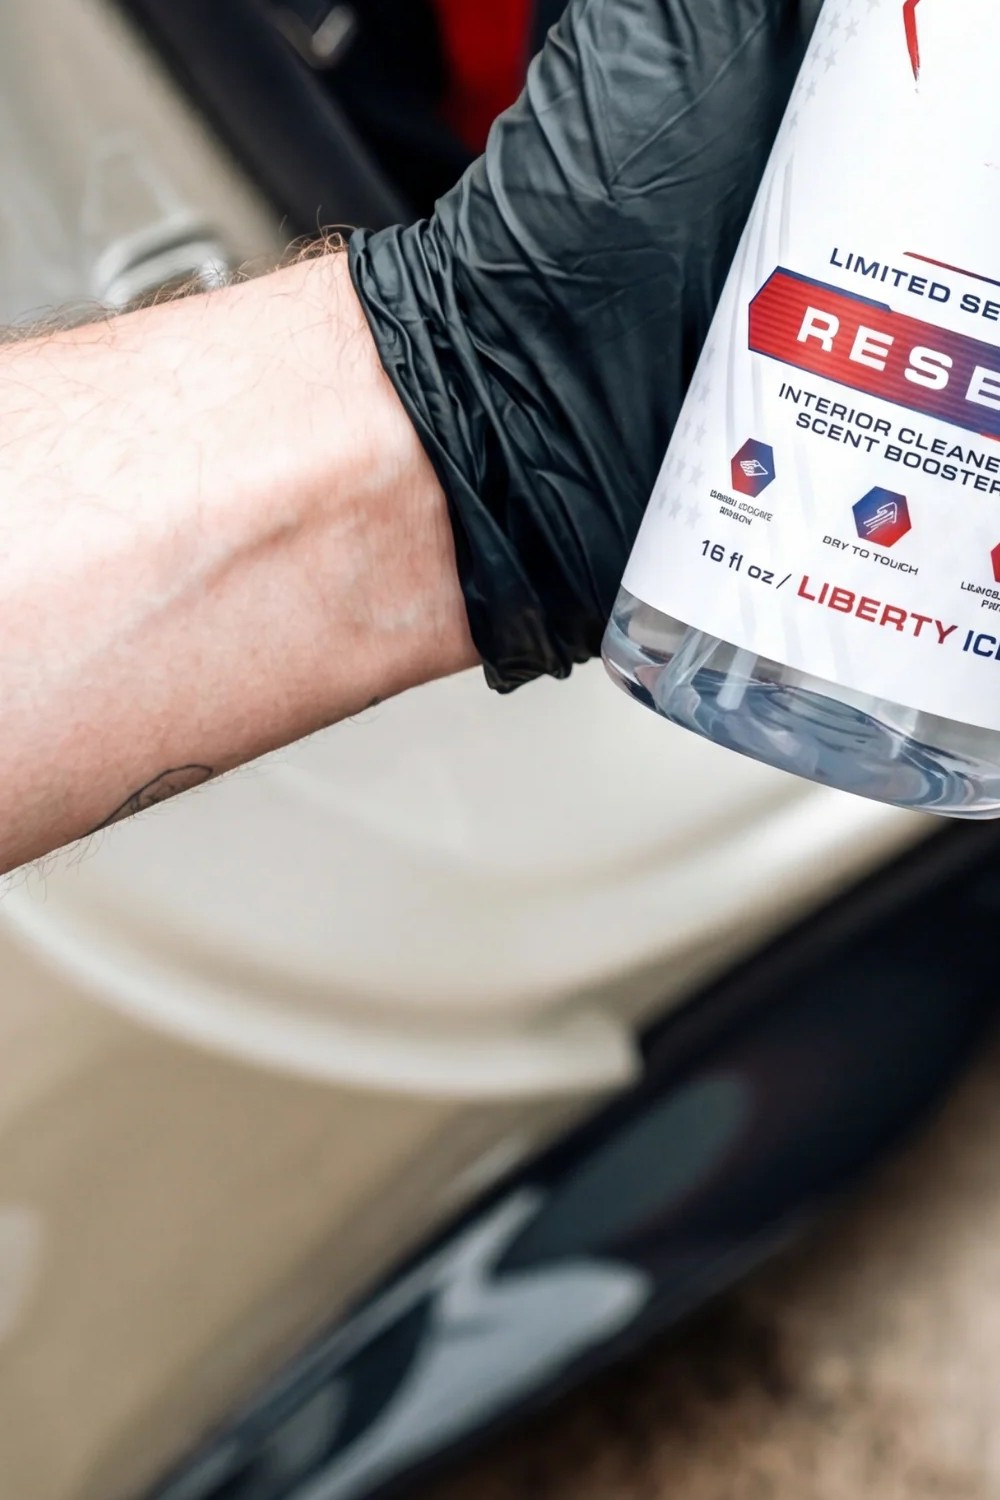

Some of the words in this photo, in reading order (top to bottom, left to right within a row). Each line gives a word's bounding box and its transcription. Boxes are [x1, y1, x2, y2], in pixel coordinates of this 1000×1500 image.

[829, 247, 951, 303] LIMITED
[778, 383, 892, 437] INTERIOR
[795, 412, 880, 453] SCENT
[822, 535, 850, 551] DRY
[852, 545, 870, 559] TO
[702, 539, 726, 563] 16
[728, 551, 744, 572] fl
[747, 565, 775, 585] oz
[797, 575, 958, 645] LIBERTY
